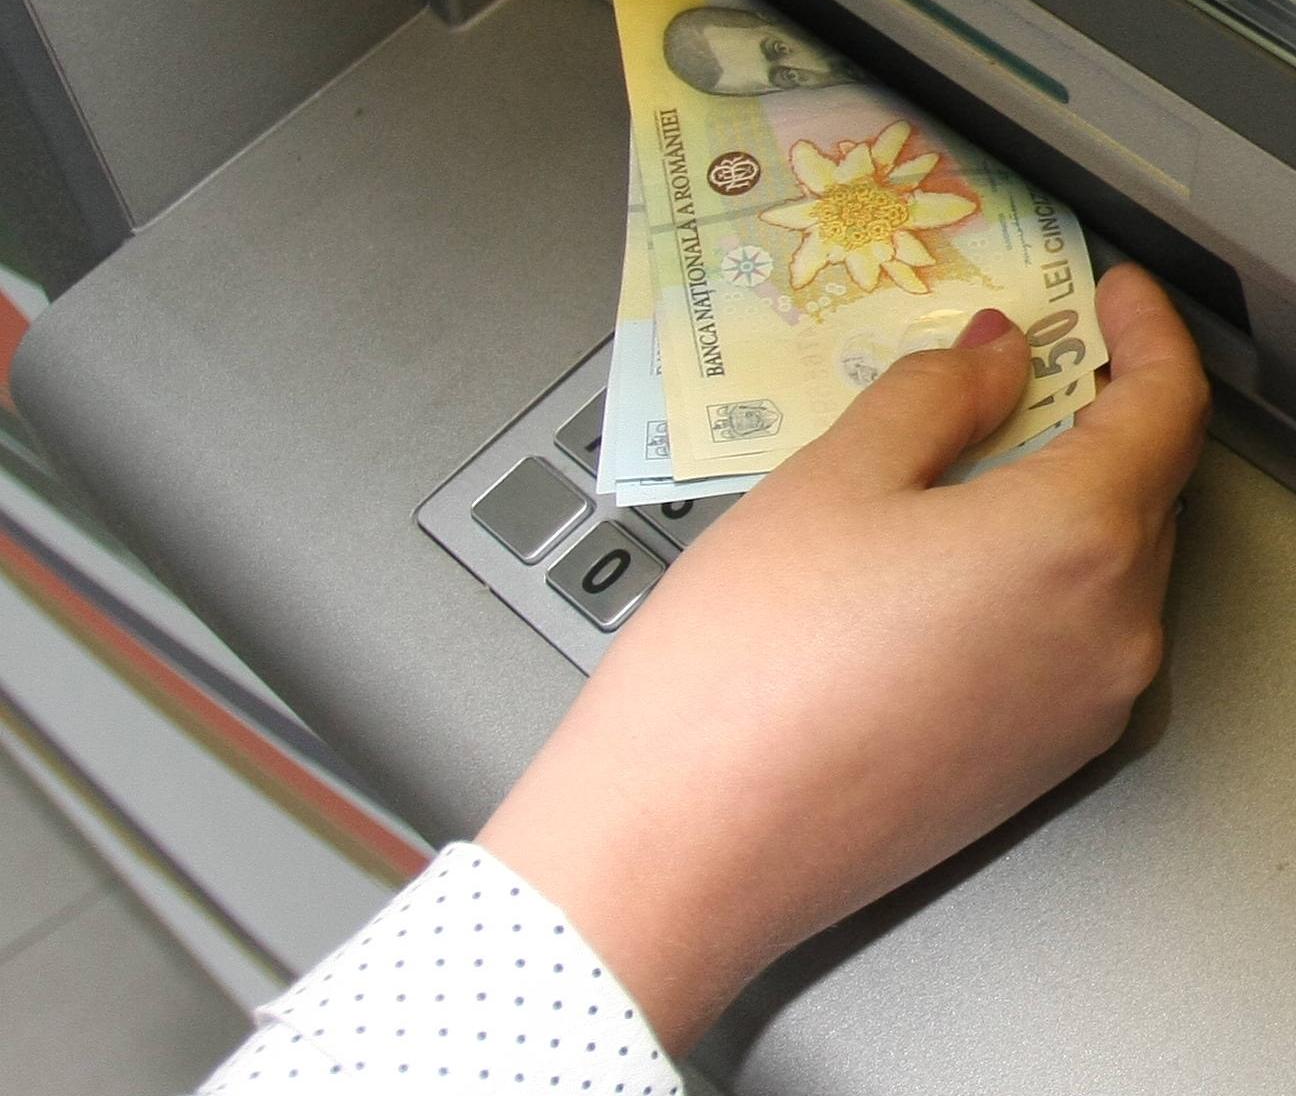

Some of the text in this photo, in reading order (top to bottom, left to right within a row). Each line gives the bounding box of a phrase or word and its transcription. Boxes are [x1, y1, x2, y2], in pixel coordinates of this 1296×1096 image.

[676, 202, 695, 216] A
[1041, 259, 1075, 304] LEI
[698, 322, 725, 378] BANCA
[1026, 309, 1087, 380] 50
[582, 549, 631, 594] 0
